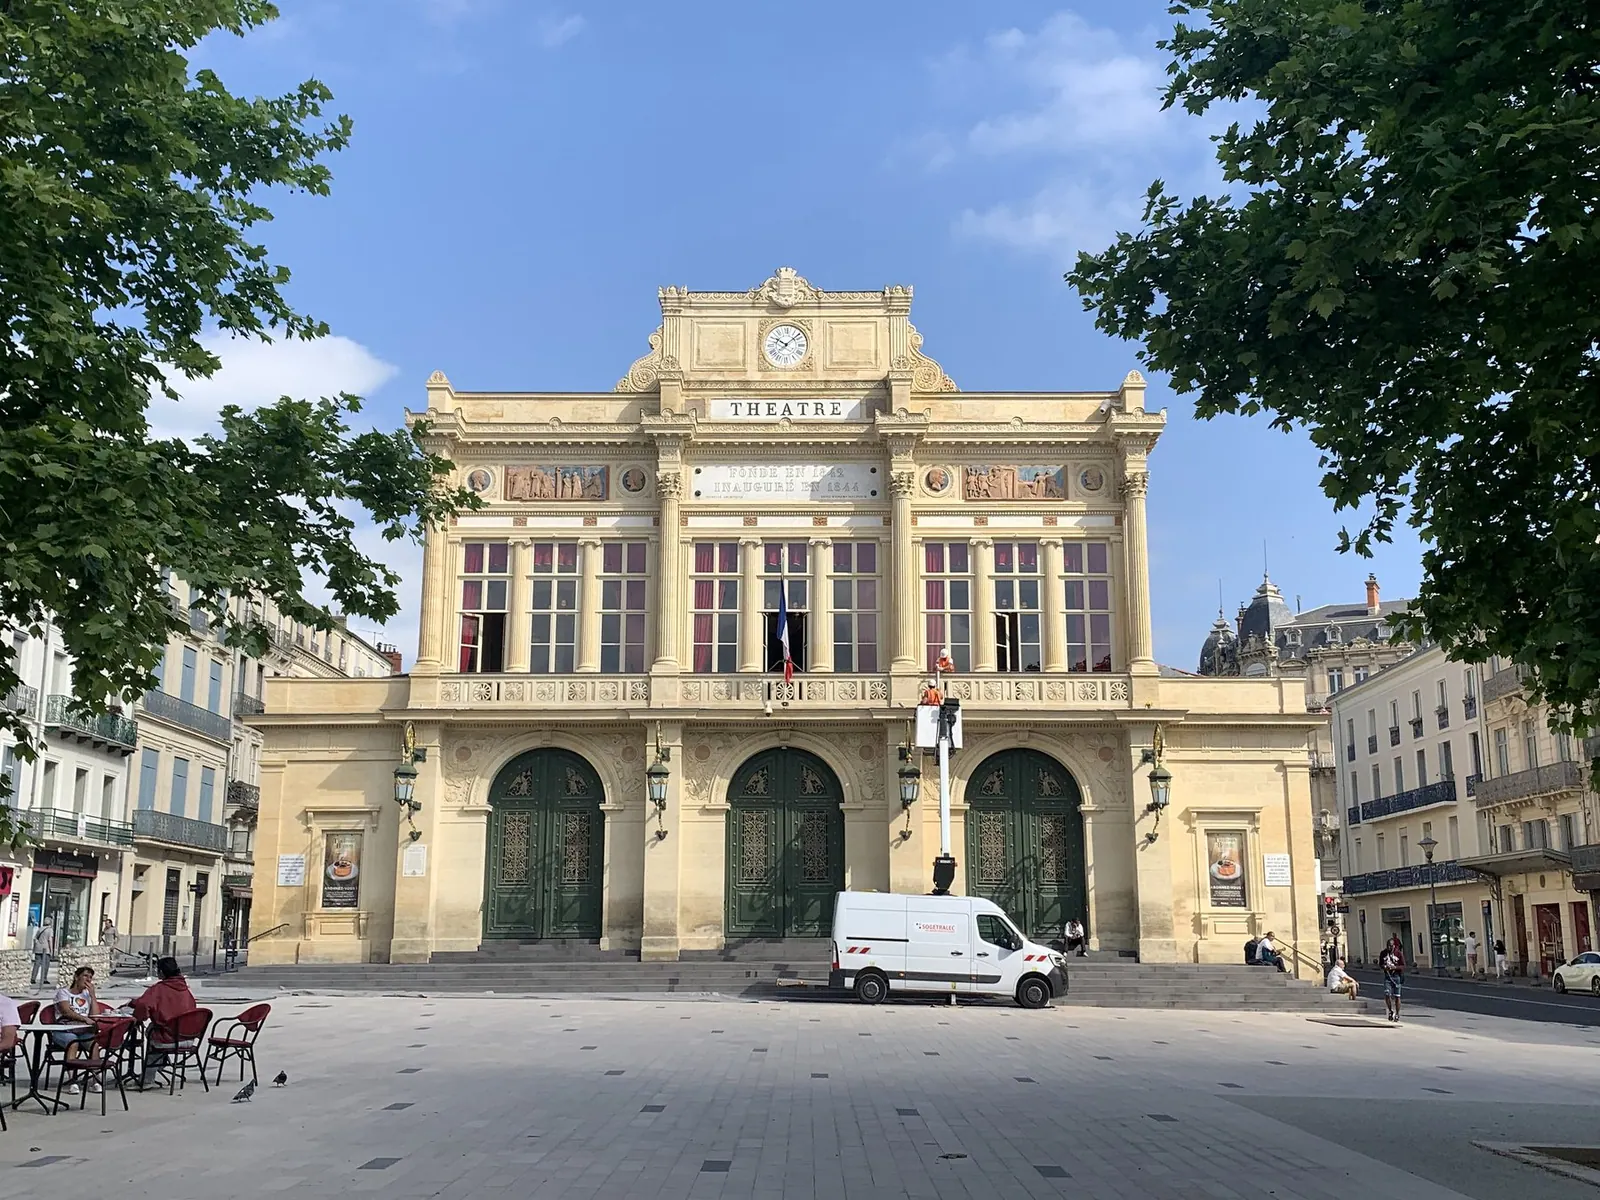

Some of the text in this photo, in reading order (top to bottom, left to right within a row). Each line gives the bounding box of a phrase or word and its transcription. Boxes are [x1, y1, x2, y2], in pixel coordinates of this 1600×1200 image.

[730, 402, 842, 416] THEATRE
[785, 467, 805, 478] EN
[812, 467, 845, 478] 1842
[714, 479, 860, 492] INAUGURÉ EN 1844
